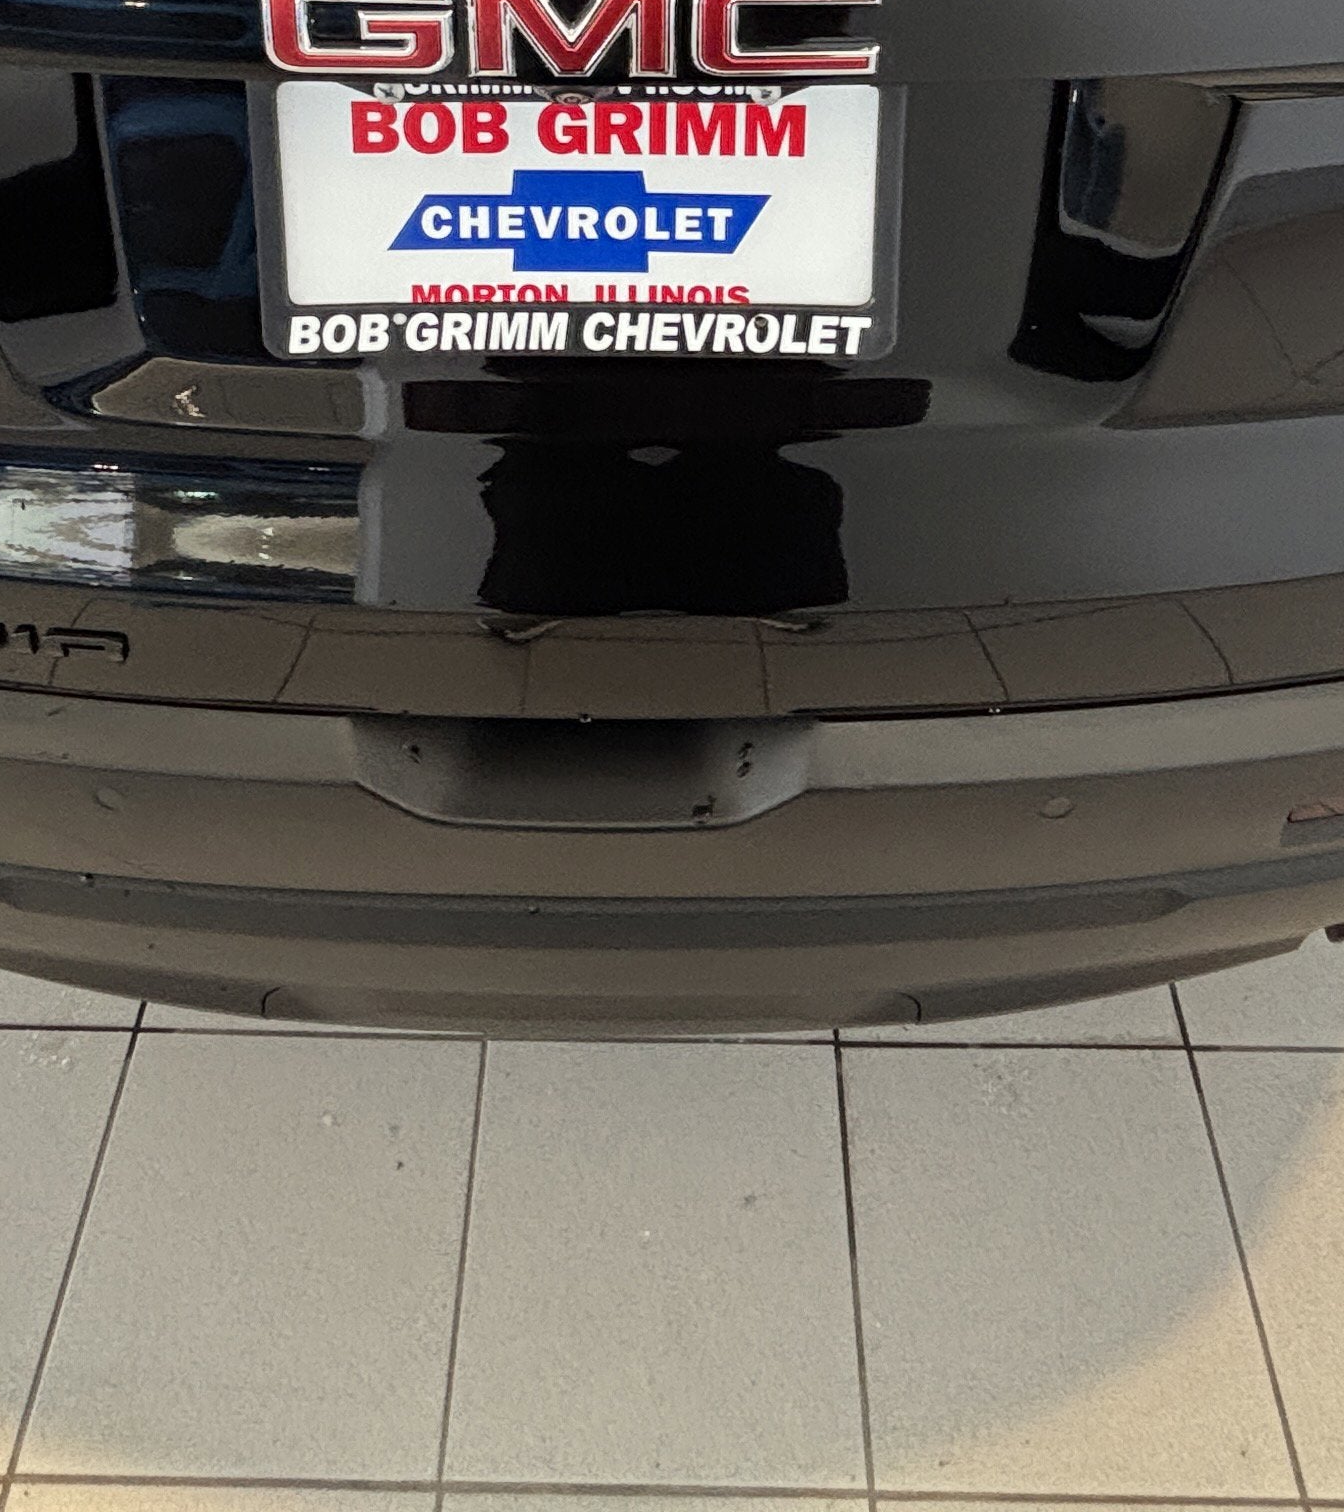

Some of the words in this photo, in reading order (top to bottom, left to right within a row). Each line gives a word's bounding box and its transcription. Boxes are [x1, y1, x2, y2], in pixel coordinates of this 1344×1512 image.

[351, 100, 510, 155] BOB
[537, 101, 807, 157] GRIMM
[421, 205, 734, 241] CHEVROLET
[411, 283, 569, 305] MORTON
[288, 313, 390, 354] BOB
[405, 311, 570, 353] GRIMM
[582, 311, 874, 355] CHEVROLET
